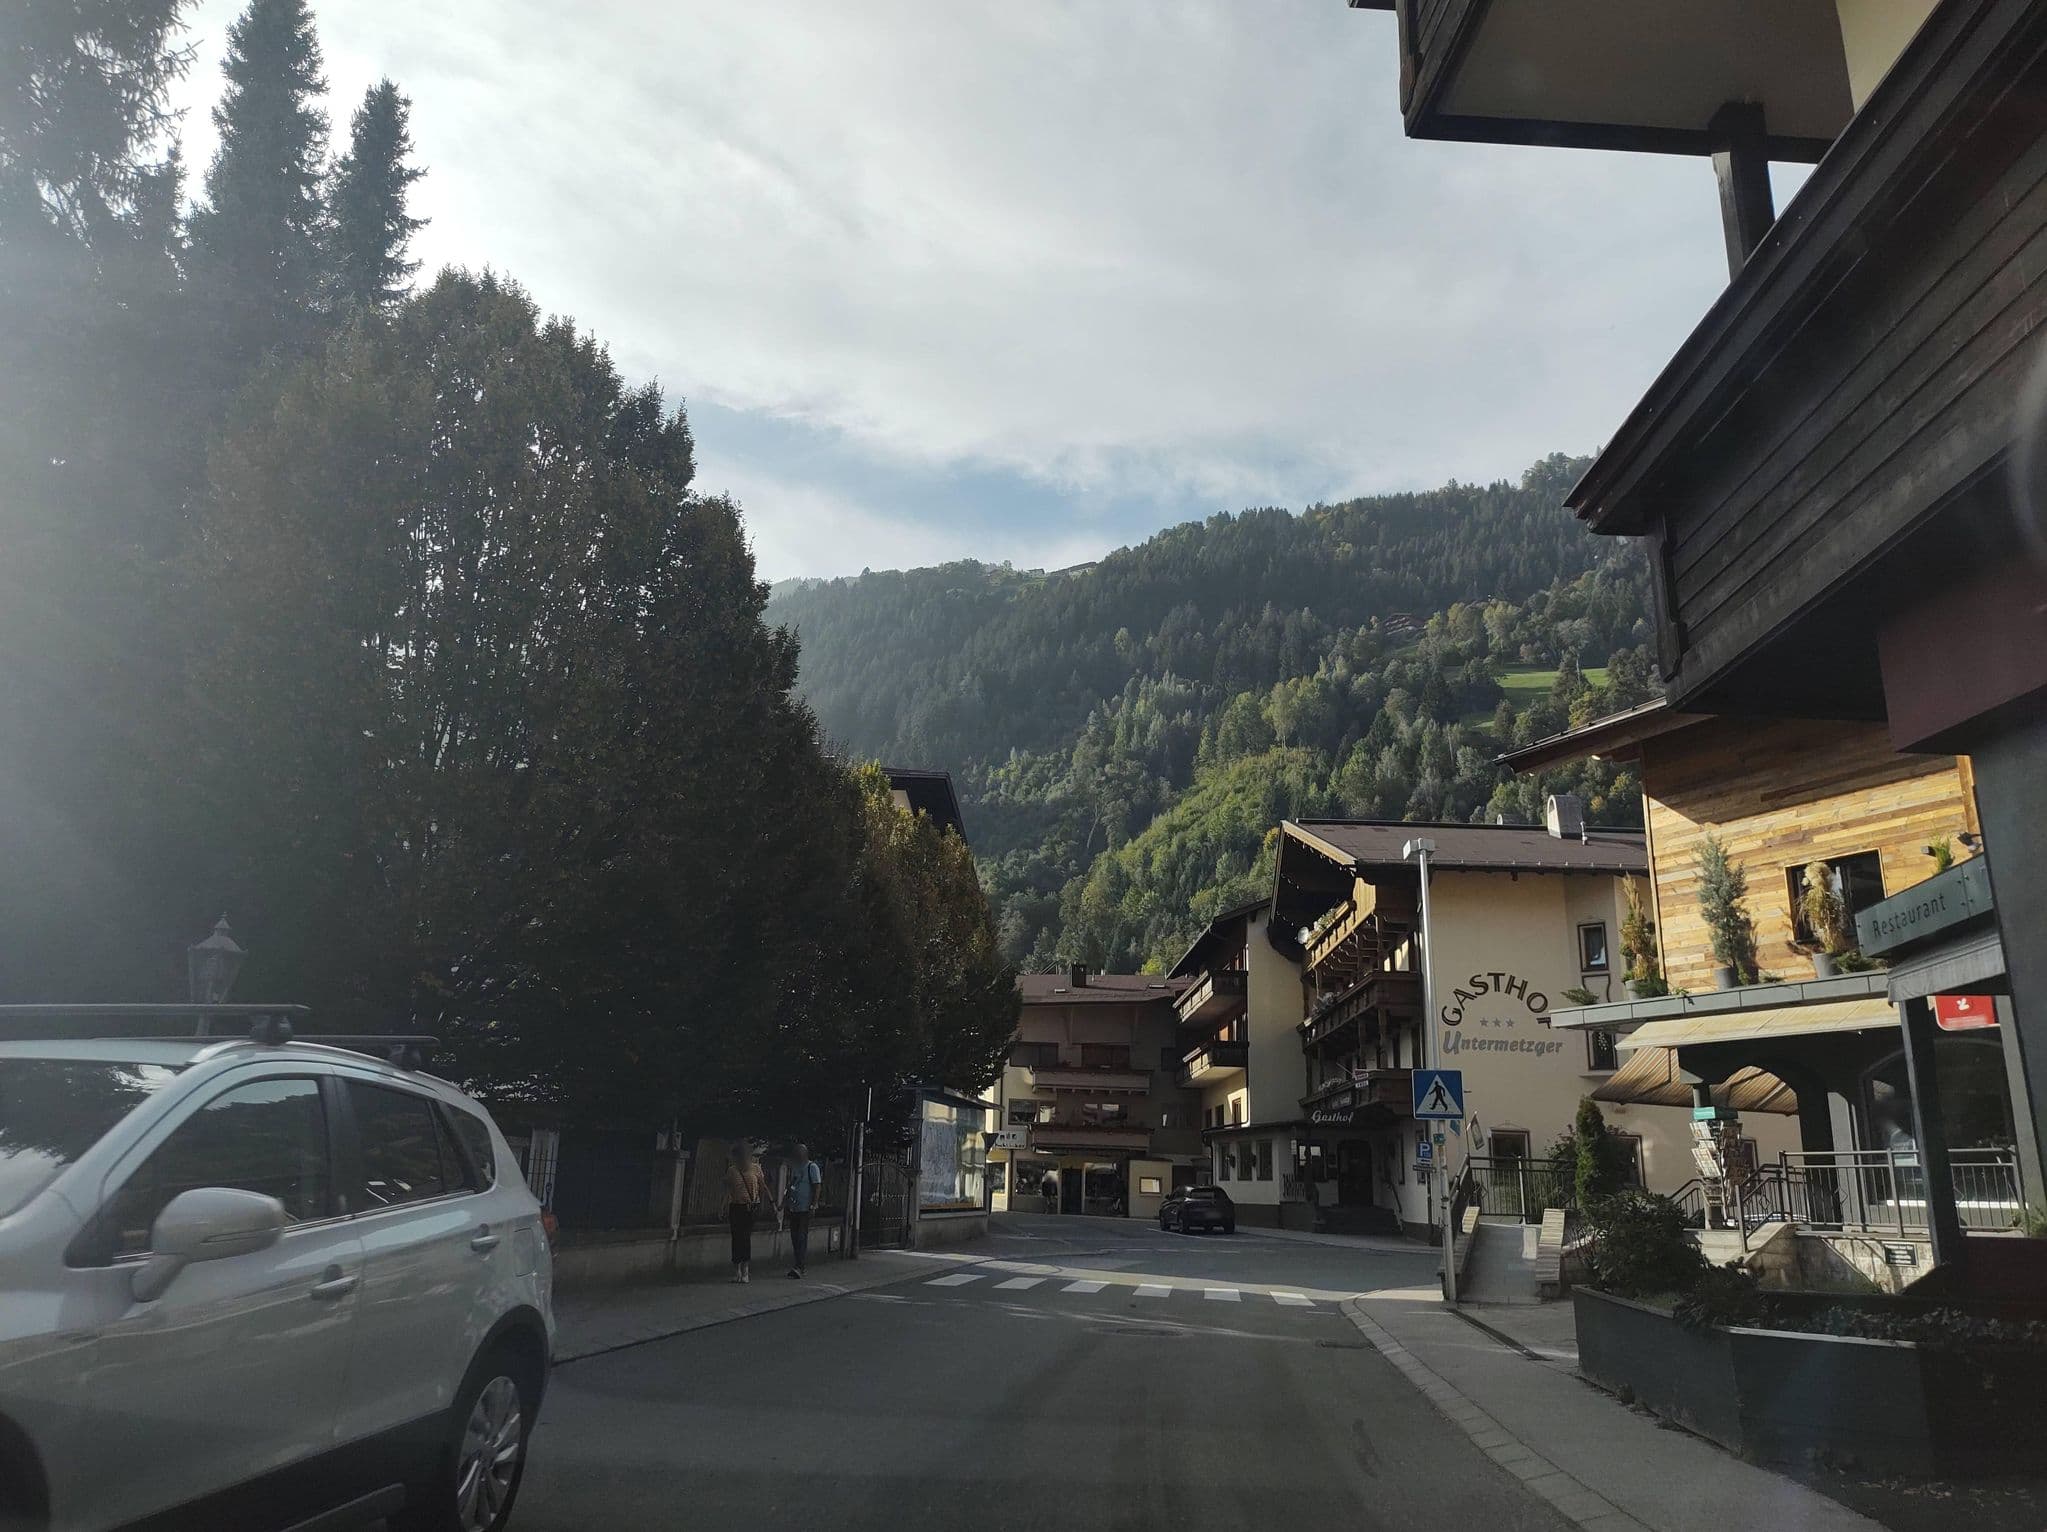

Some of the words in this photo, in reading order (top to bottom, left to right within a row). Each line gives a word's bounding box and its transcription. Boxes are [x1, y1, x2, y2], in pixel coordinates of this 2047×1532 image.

[1872, 896, 1947, 937] Restaurant
[1443, 1031, 1563, 1057] Untermetzger
[1311, 1110, 1354, 1124] Gasthof
[1420, 1143, 1430, 1157] P
